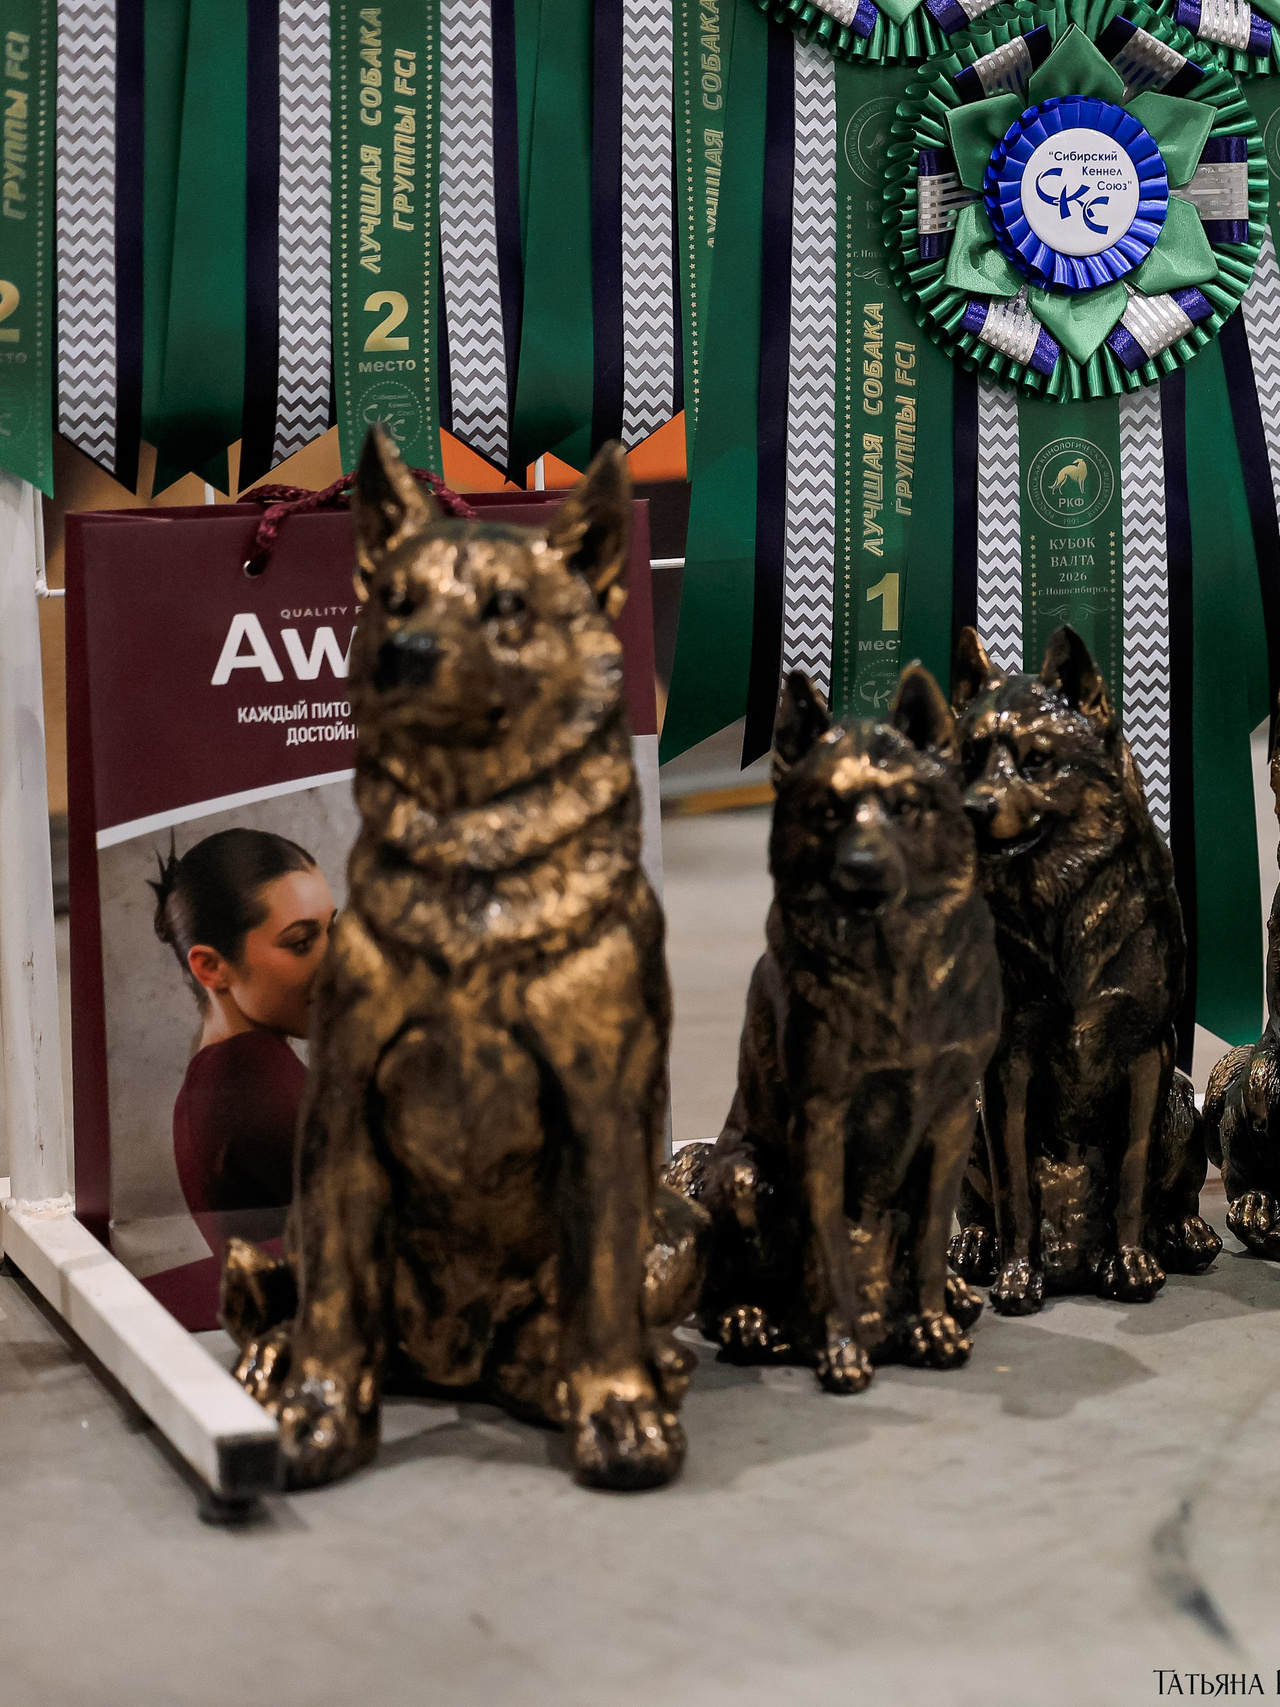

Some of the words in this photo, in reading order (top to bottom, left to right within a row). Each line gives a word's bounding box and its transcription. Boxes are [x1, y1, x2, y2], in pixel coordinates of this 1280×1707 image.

[6, 30, 31, 80] FCI
[360, 7, 383, 126] СОБАКА
[394, 48, 417, 96] FCI
[2, 89, 29, 220] ГРУППЫ
[393, 105, 416, 232] ГРУППЫ
[1048, 150, 1118, 163] "Сибирский
[1081, 166, 1123, 176] Кеннел
[1096, 180, 1133, 191] Союз"
[360, 144, 382, 275] ЛУЧШАЯ
[363, 290, 410, 352] 2
[358, 359, 417, 374] место
[863, 302, 884, 416] СОБАКА
[895, 341, 916, 386] FCI
[895, 395, 916, 516] ГРУППЫ
[863, 432, 884, 557] ЛУЧШАЯ
[1058, 497, 1085, 508] РКФ
[1049, 537, 1096, 550] КУБОК
[1051, 554, 1095, 567] ВАЛТА
[1046, 585, 1109, 596] Новосибирск
[1059, 571, 1087, 582] 2026
[280, 606, 348, 620] QUALITY
[866, 572, 900, 631] 1
[237, 699, 309, 724] КАЖДЫЙ
